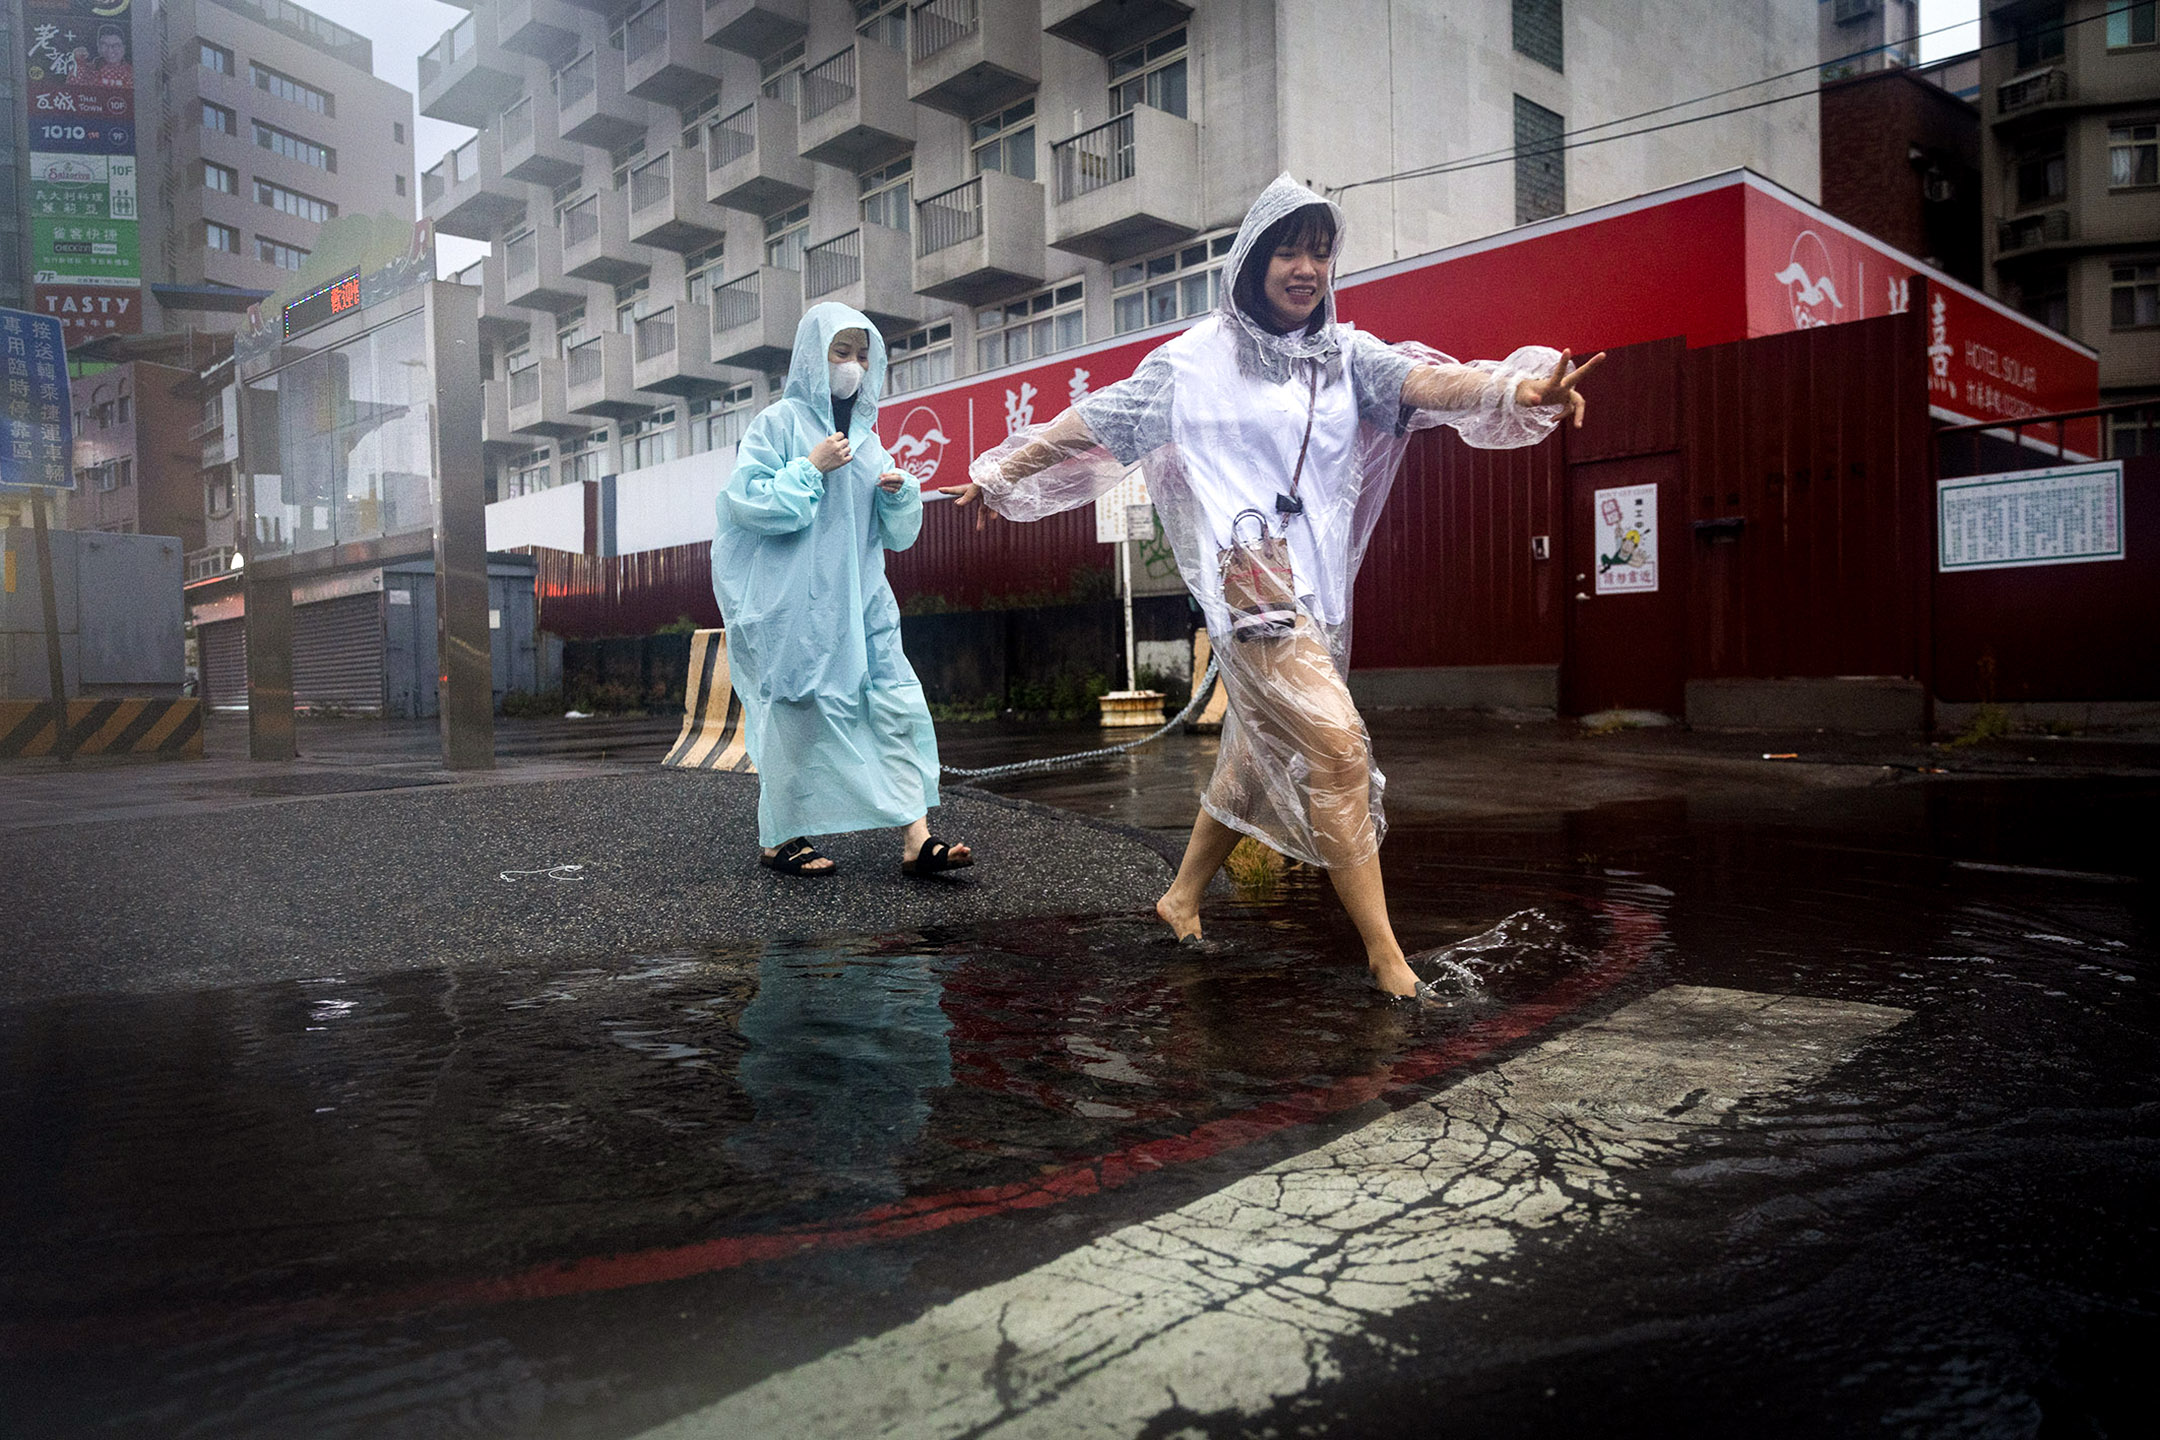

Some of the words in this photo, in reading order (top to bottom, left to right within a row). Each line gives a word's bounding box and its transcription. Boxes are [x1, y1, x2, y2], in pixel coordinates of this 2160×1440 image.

[78, 103, 103, 112] TOWN
[41, 125, 85, 140] 1010
[112, 165, 133, 176] 10F
[40, 272, 55, 282] 7F
[45, 295, 130, 314] TASTY
[1965, 339, 2001, 380] HOTEL
[2001, 356, 2038, 394] SOLAR
[3, 315, 33, 460] 專用臨時停靠區
[32, 320, 65, 482] 接送轉乘捷運車輛
